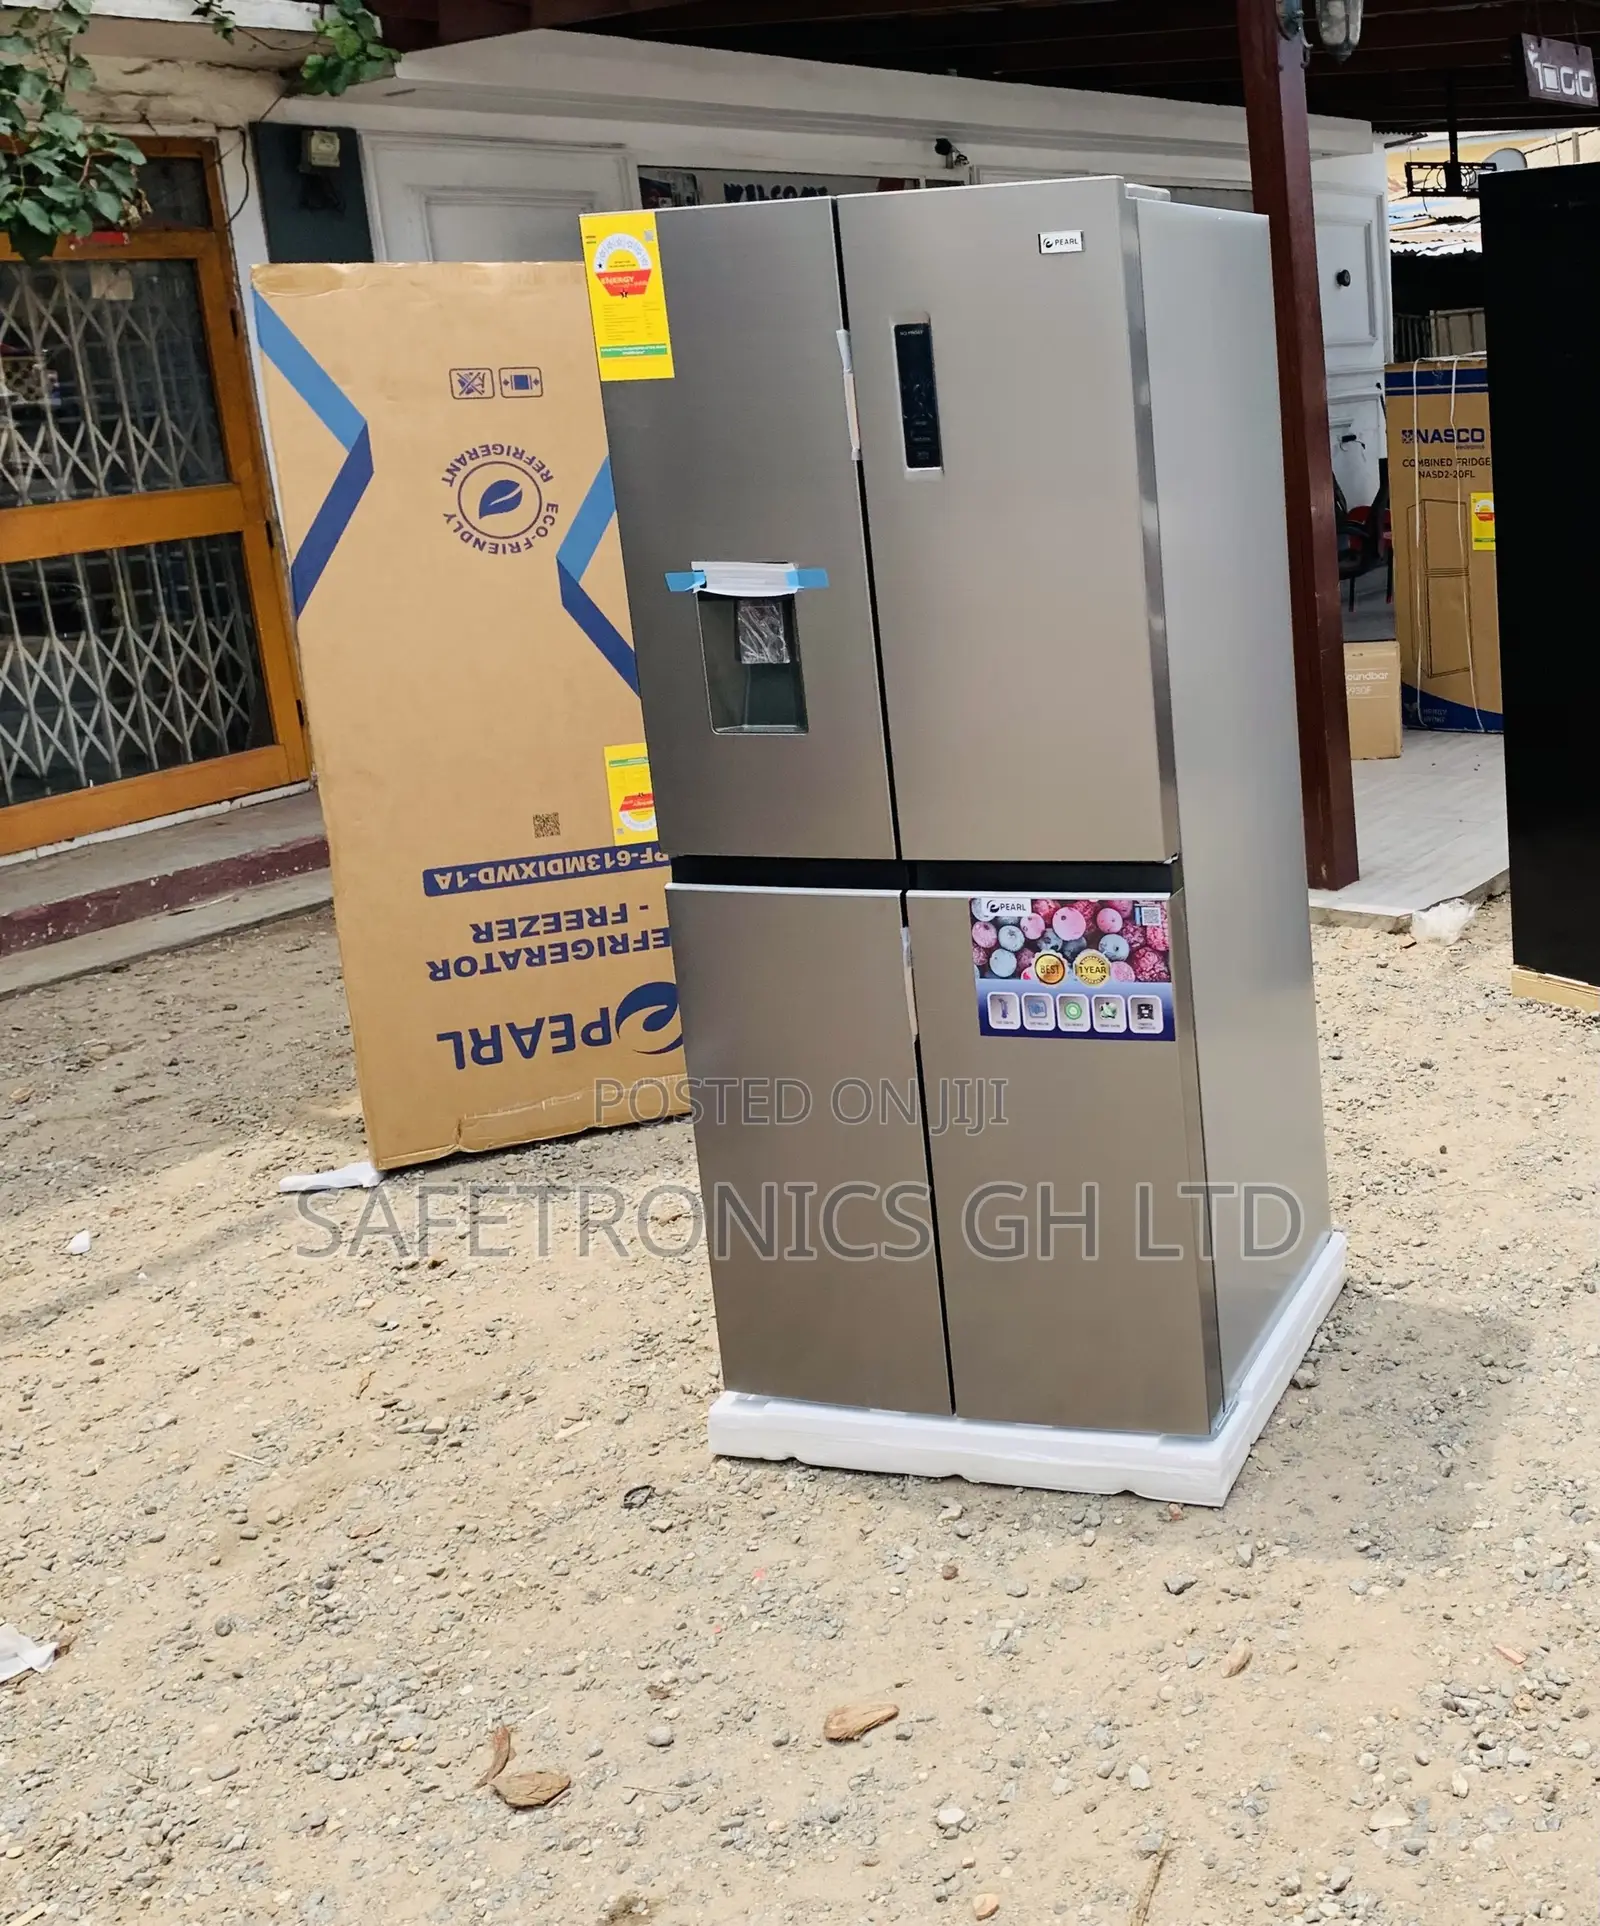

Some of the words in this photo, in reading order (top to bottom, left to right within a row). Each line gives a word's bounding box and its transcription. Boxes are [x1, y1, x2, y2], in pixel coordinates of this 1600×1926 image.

[1054, 238, 1079, 246] PEARL
[1417, 428, 1485, 443] NASCO
[441, 443, 554, 487] REFRIGERANT
[1402, 458, 1452, 467] COMBINED
[1456, 457, 1491, 466] FRIDGE
[443, 503, 559, 555] ECO-FRIENDLY
[1345, 671, 1388, 681] oundbar
[1000, 903, 1026, 911] PEARL
[470, 903, 628, 943] FREEZER
[426, 927, 671, 981] EFRIGERATOR
[1040, 964, 1059, 974] BEST
[436, 1007, 612, 1070] PEARL
